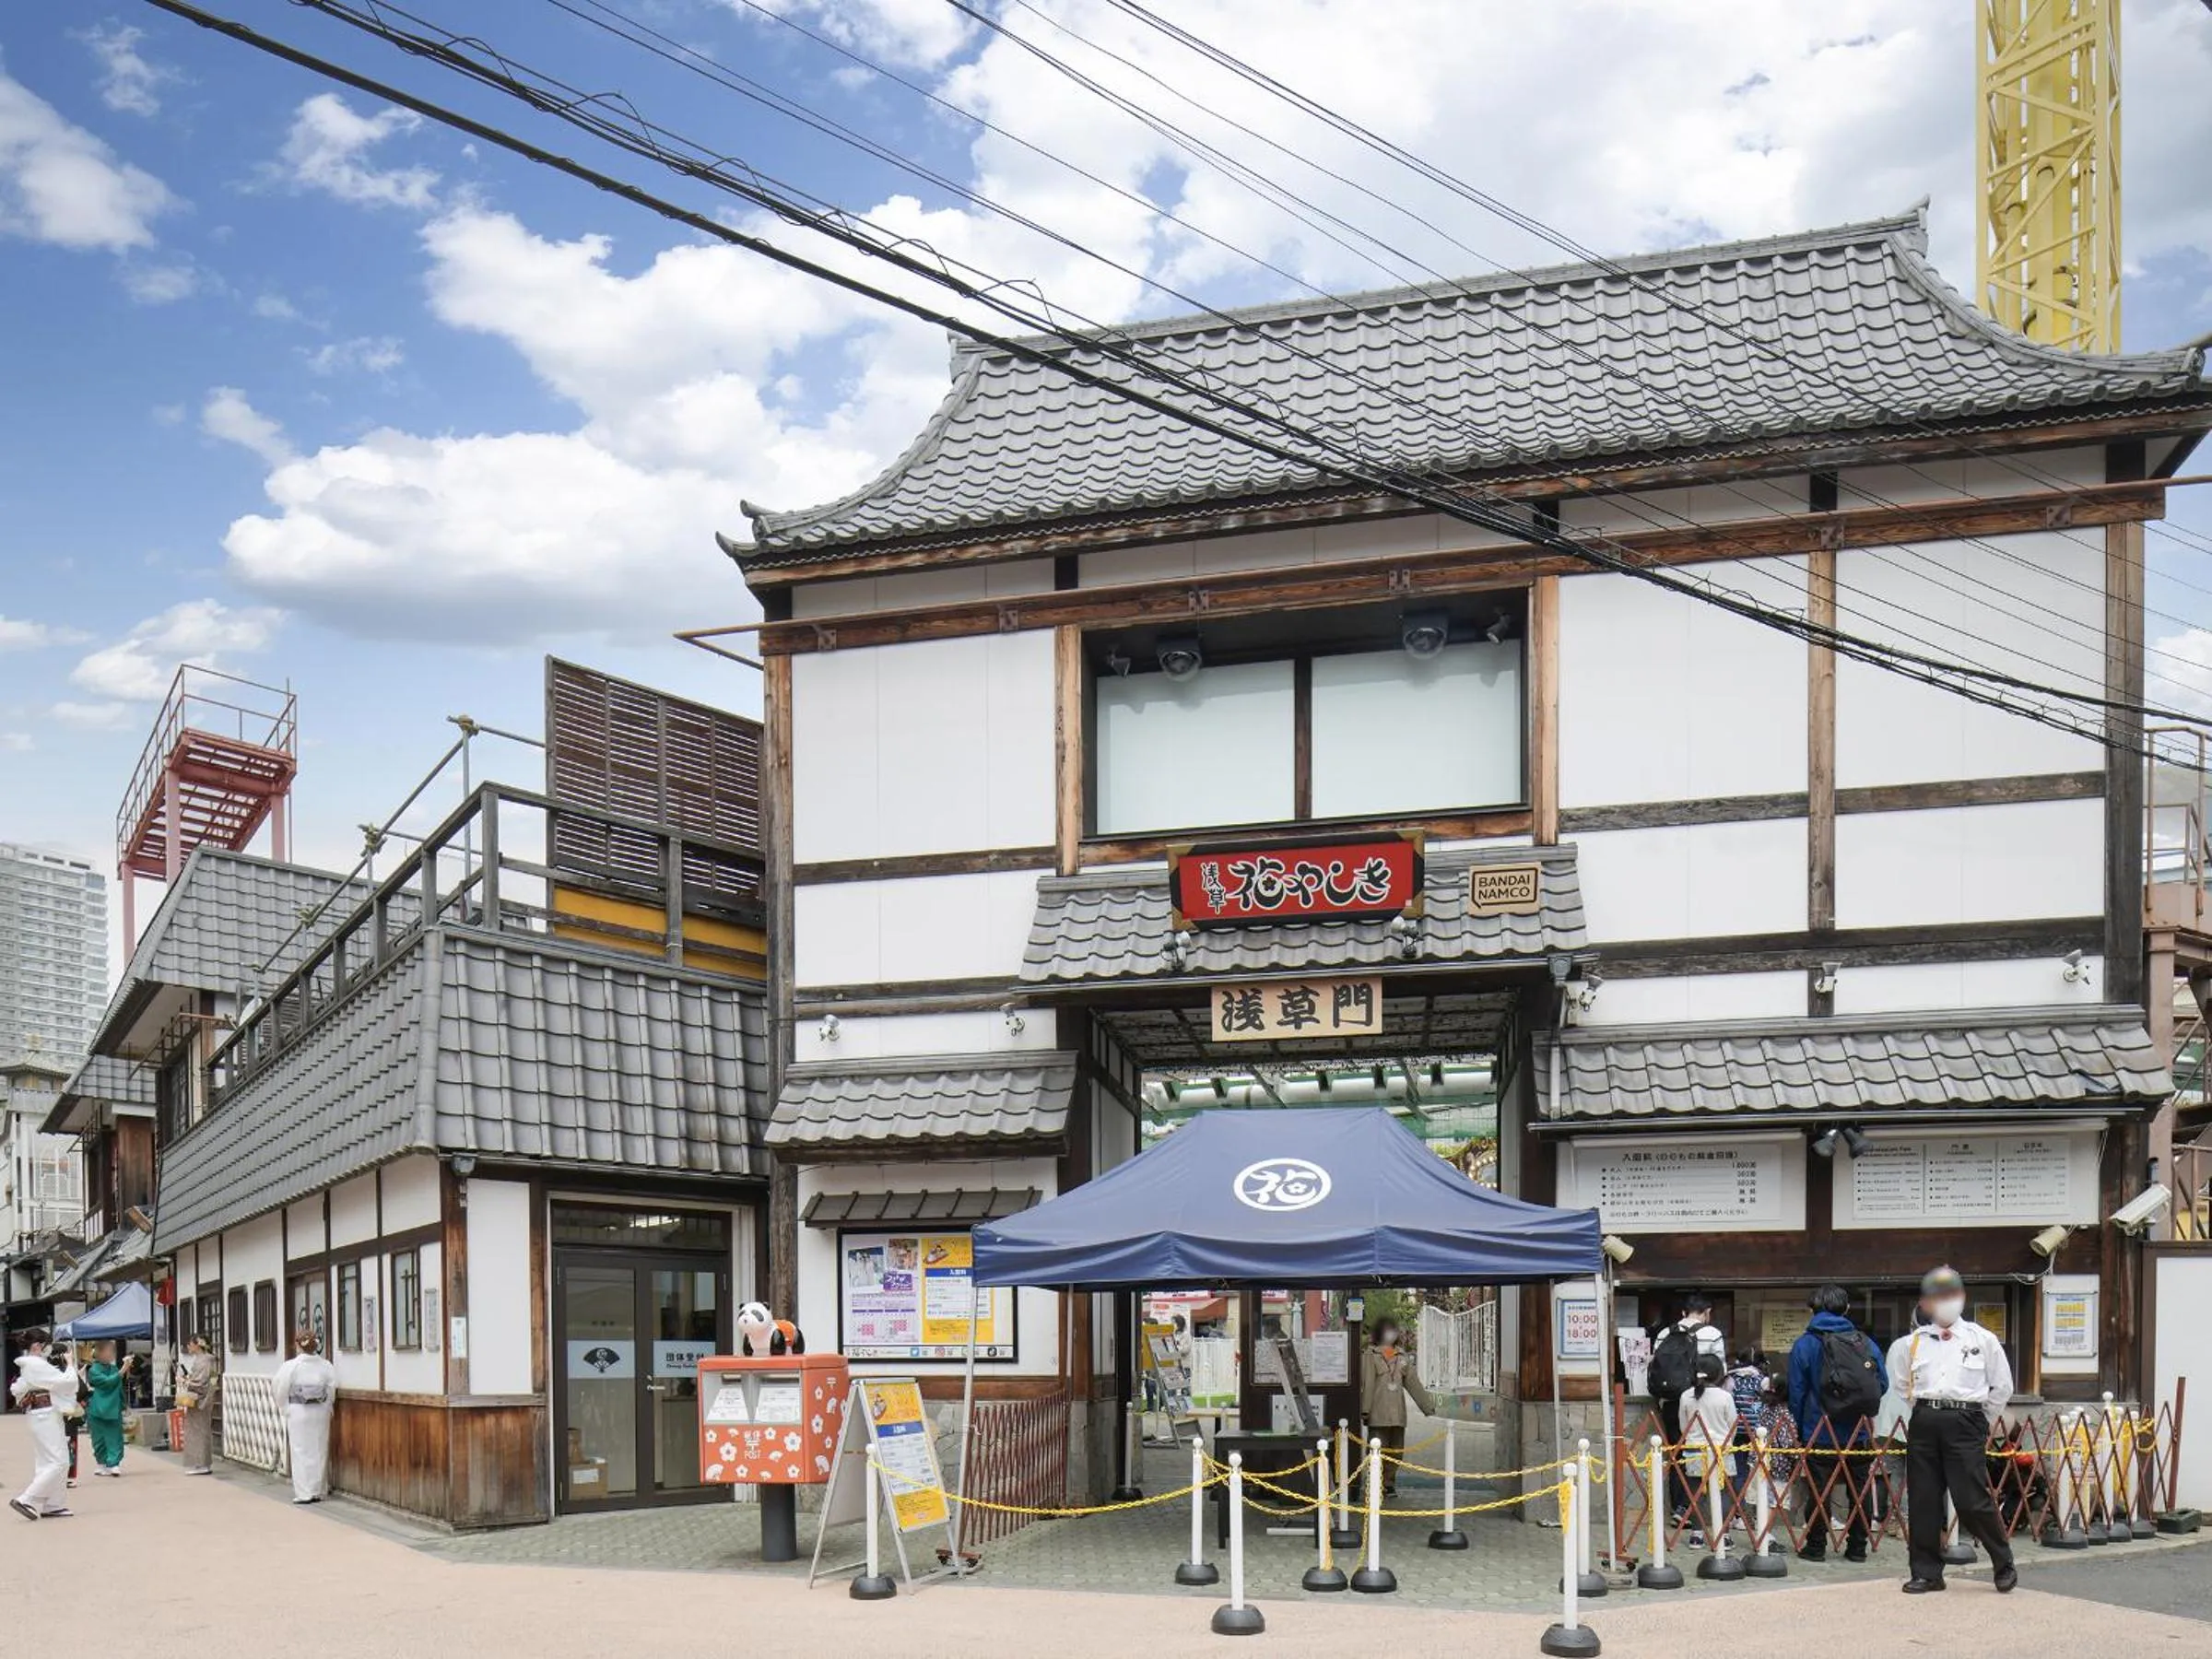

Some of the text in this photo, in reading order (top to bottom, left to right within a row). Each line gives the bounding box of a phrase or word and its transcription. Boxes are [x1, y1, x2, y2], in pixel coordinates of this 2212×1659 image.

[1201, 862, 1227, 914] 浅草
[1227, 855, 1391, 911] 花やしき
[1478, 874, 1531, 888] BANDAI
[1478, 886, 1531, 900] NAMCO
[1221, 982, 1373, 1032] 浅草門
[1568, 1314, 1596, 1324] 10:00
